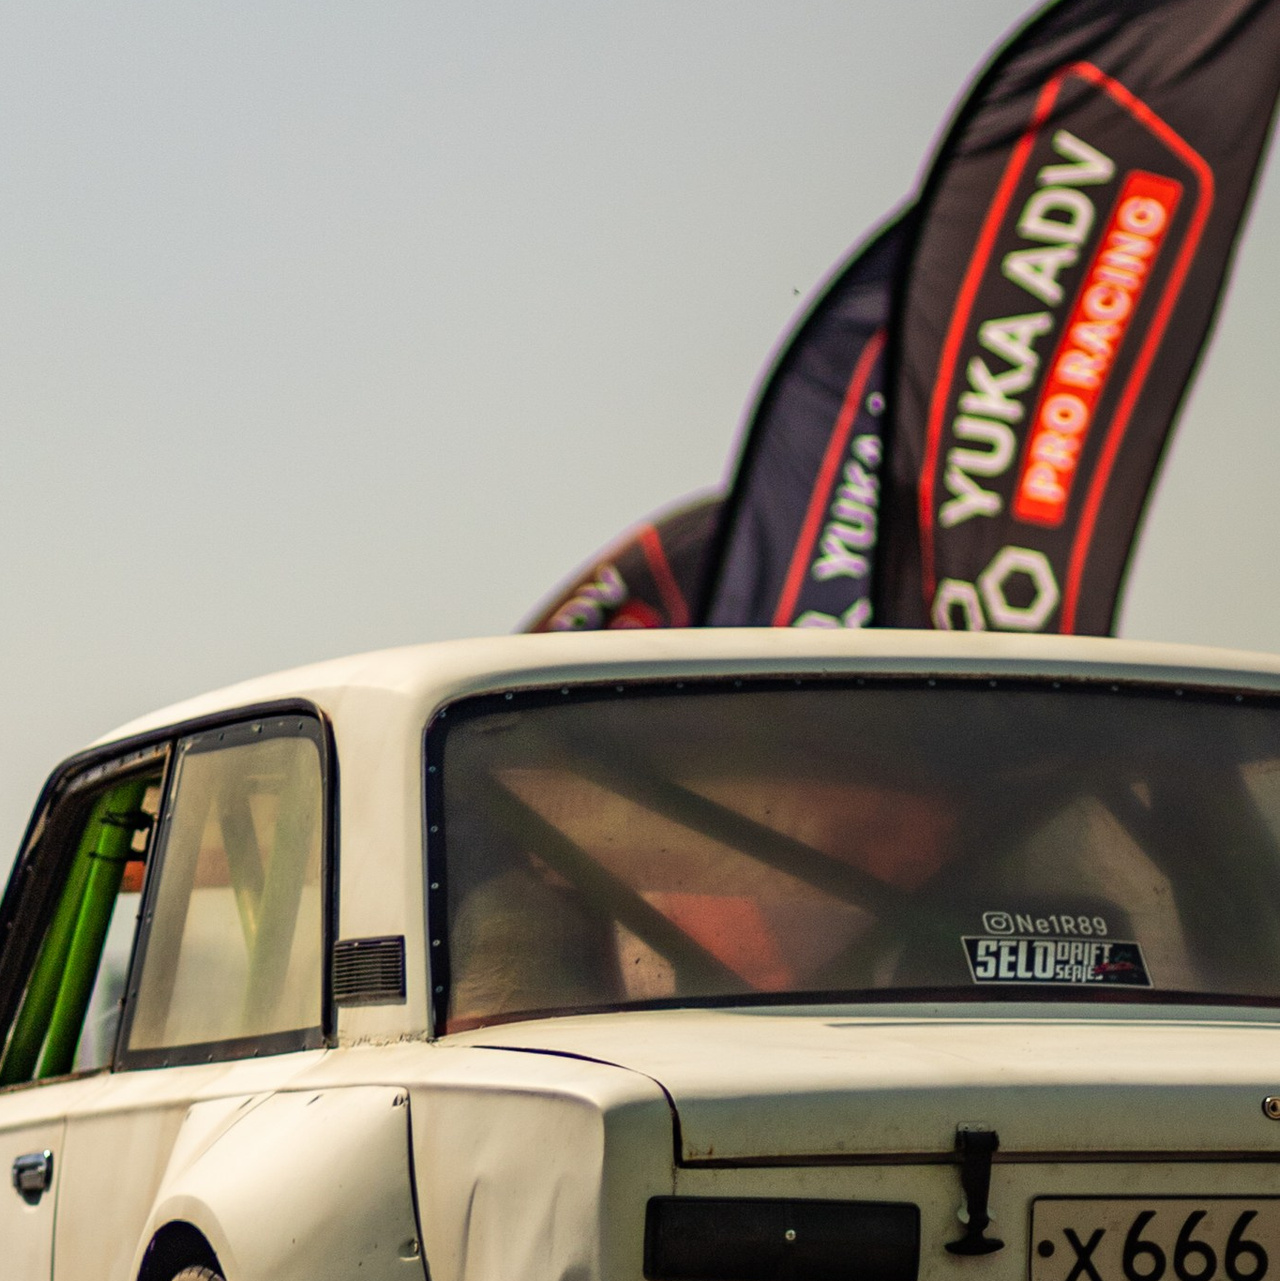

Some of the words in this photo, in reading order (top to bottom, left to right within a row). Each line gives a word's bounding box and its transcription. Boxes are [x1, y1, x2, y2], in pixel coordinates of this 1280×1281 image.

[938, 311, 1054, 528] YUKA
[1001, 127, 1117, 307] ADV
[1055, 195, 1169, 391] RACING
[1023, 392, 1090, 505] PRO
[976, 940, 1056, 979] SELO
[1056, 942, 1113, 966] DRIFT
